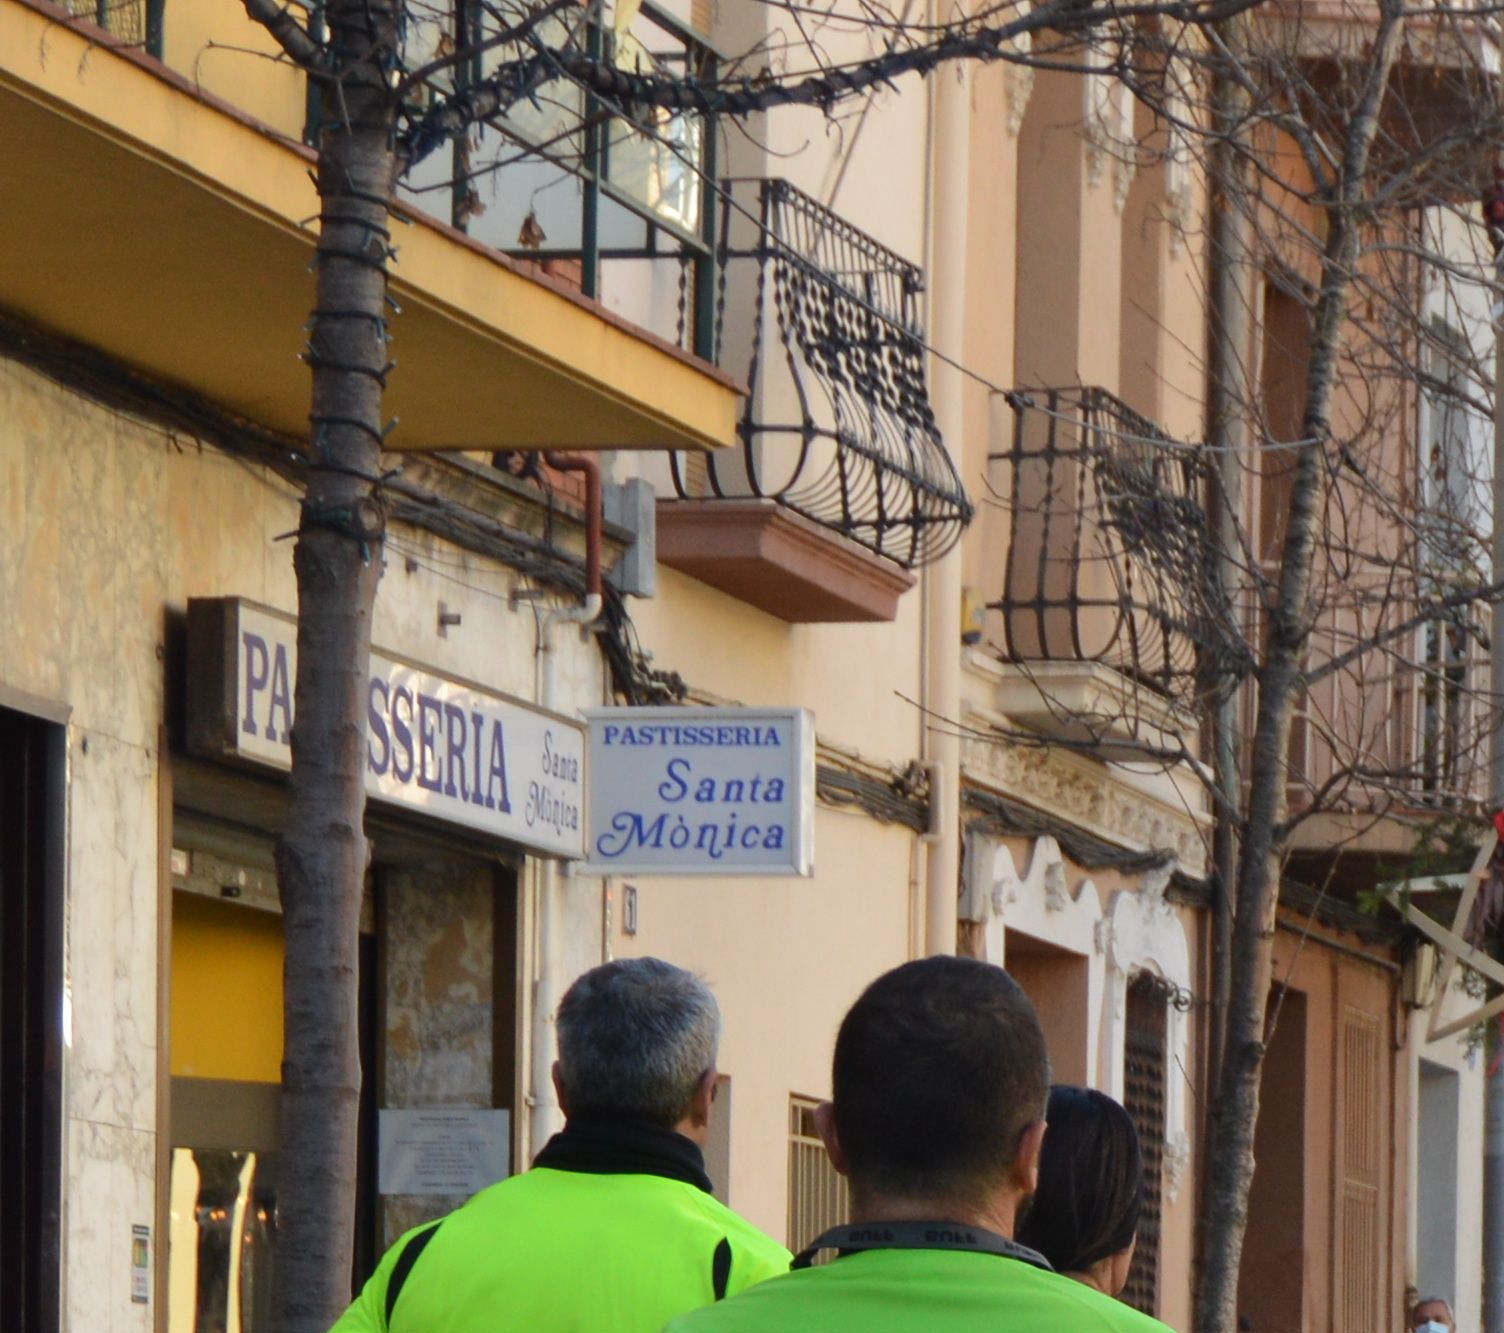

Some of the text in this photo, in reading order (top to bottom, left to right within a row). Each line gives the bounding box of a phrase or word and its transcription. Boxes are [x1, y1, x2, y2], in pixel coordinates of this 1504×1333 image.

[242, 630, 512, 815] PASSERIA
[603, 725, 781, 747] PASTISSERIA
[542, 730, 579, 784] Santa
[658, 758, 785, 803] Santa
[596, 811, 785, 859] Mònica
